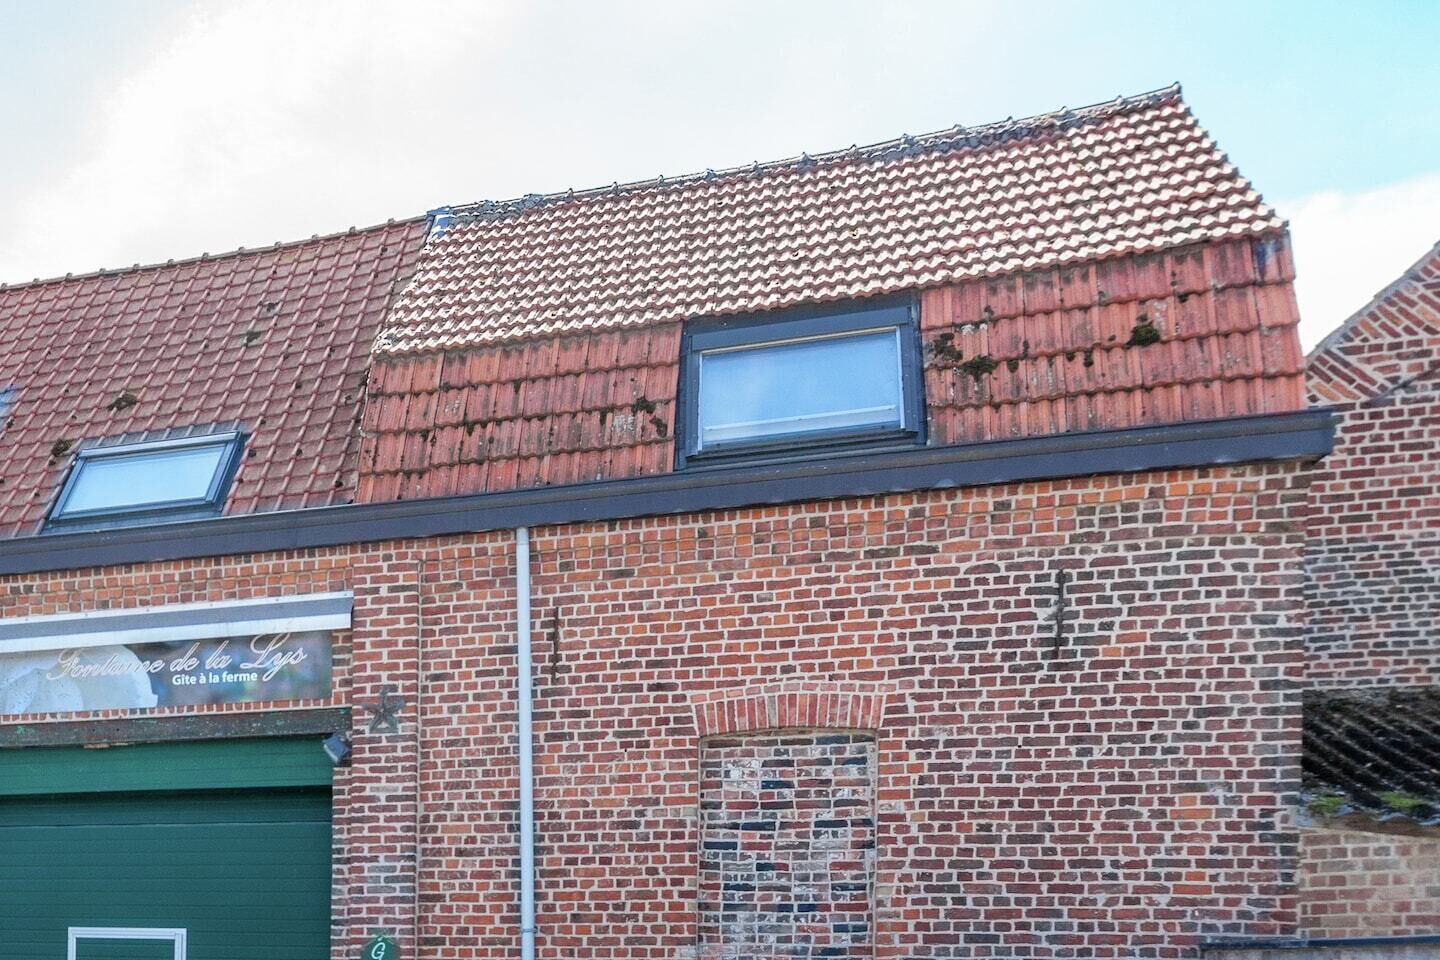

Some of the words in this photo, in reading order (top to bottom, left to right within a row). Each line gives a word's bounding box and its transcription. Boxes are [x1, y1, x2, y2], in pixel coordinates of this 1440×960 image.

[46, 647, 166, 681] Fontaine
[170, 641, 201, 672] de
[205, 640, 232, 670] la
[240, 632, 308, 682] Lys
[199, 672, 206, 684] à
[209, 672, 220, 684] la
[222, 671, 258, 683] ferme
